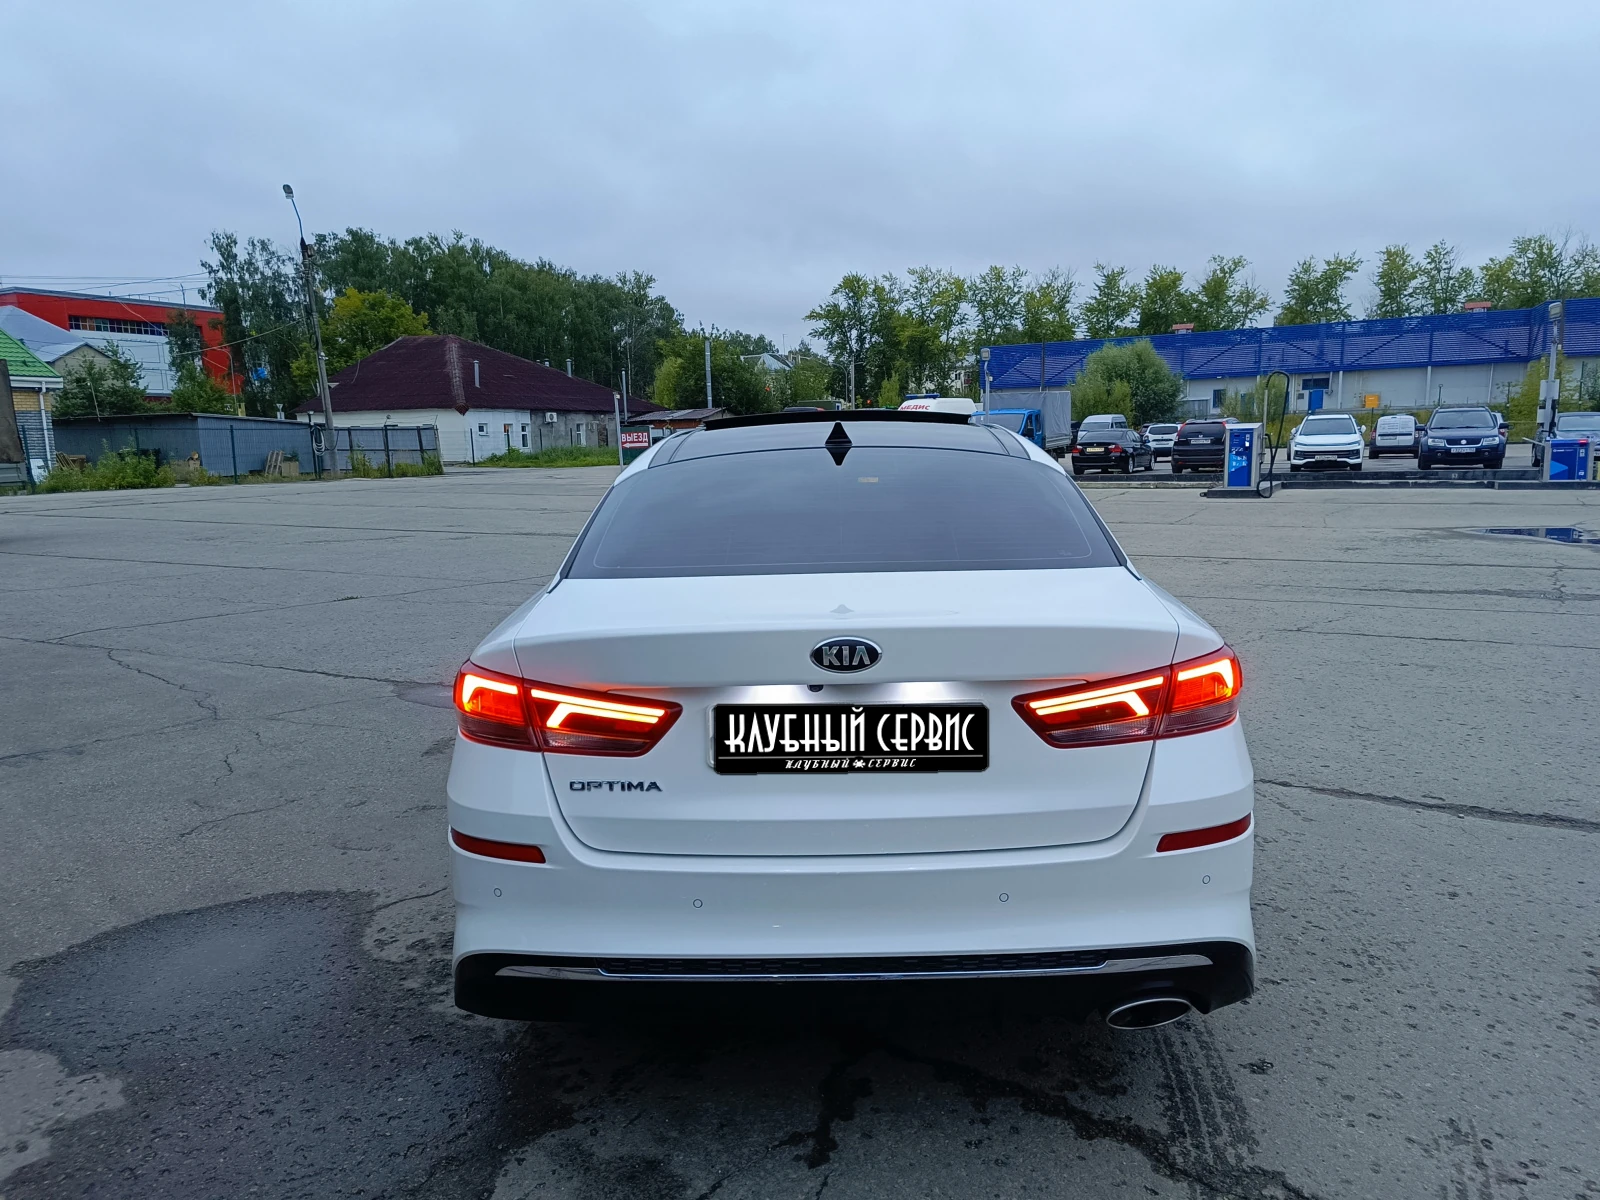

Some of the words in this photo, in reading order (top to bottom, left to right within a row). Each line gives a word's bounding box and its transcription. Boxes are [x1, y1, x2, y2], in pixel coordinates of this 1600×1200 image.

[621, 432, 649, 443] ВЫЕЗД
[821, 645, 871, 666] KIA
[569, 780, 663, 792] OPTIMA
